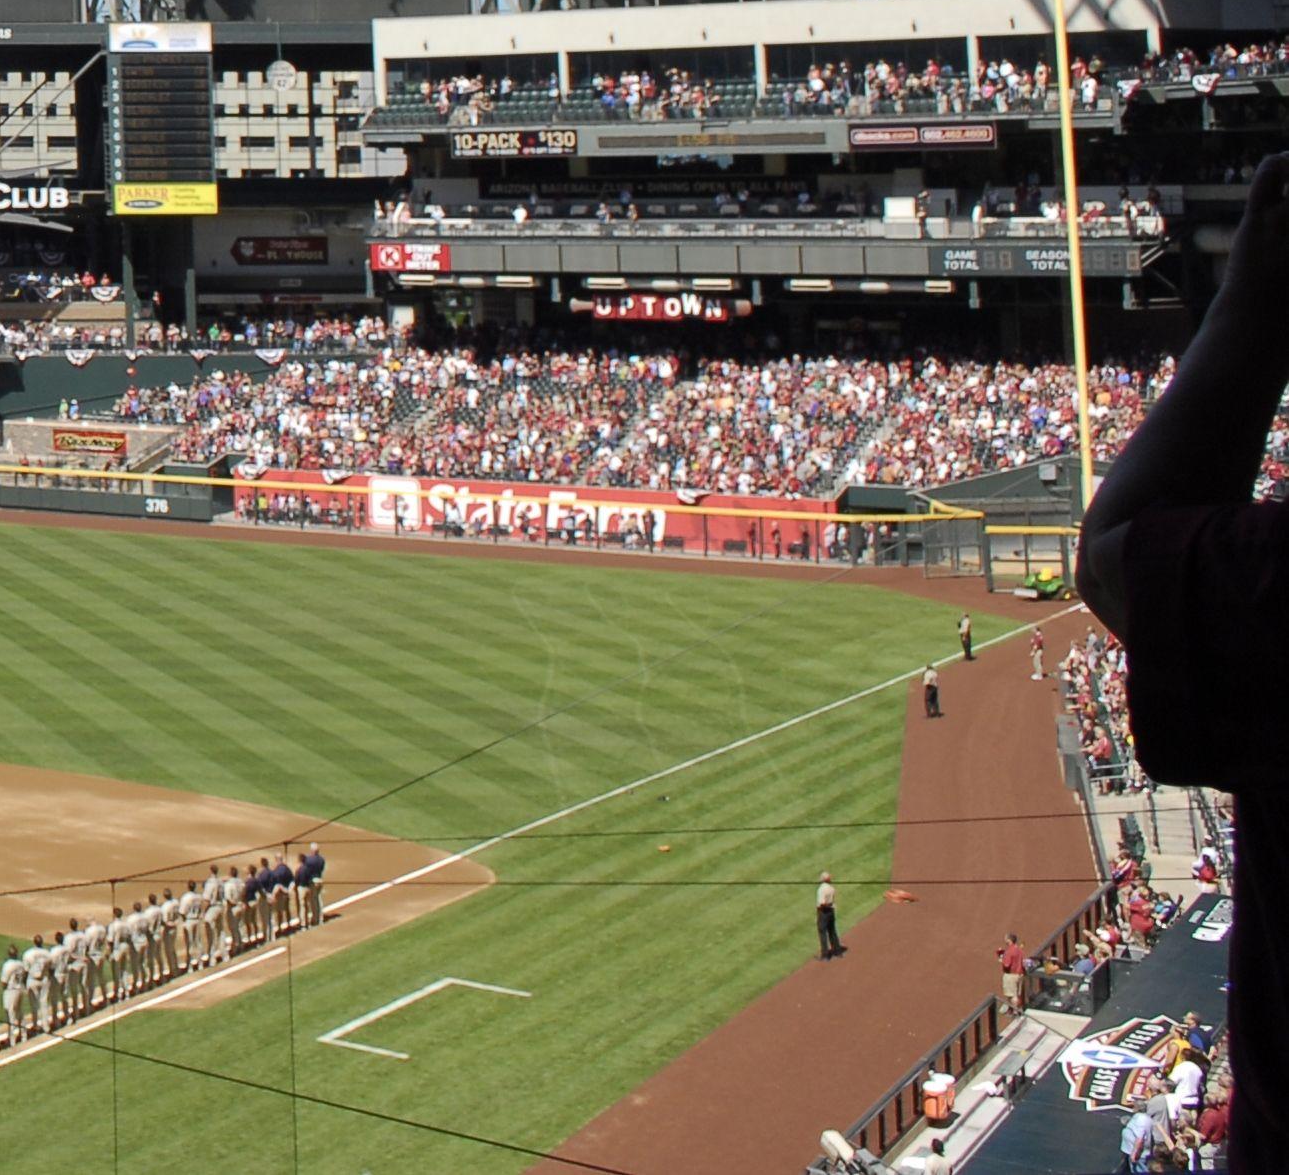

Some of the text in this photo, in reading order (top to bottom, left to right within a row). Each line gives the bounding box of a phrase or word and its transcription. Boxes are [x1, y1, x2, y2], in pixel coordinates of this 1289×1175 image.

[454, 130, 577, 150] 10-PACK $130
[854, 130, 914, 142] dbacks.com
[118, 186, 169, 202] PARKER
[488, 182, 538, 195] ARIZONA
[541, 181, 599, 194] BASEBALL
[647, 181, 690, 193] DINING
[694, 181, 726, 193] OPEN
[730, 181, 746, 192] TO
[750, 181, 775, 192] ALL
[779, 180, 808, 192] FANS
[945, 250, 977, 261] GAME
[1026, 250, 1070, 260] SEASON
[944, 260, 979, 271] TOTAL
[1032, 260, 1068, 271] TOTAL
[595, 292, 723, 319] UPTOWN
[145, 498, 169, 513] 376
[427, 484, 666, 543] State Farm
[1119, 1024, 1166, 1050] FIELD
[1088, 1068, 1121, 1101] CHASE
